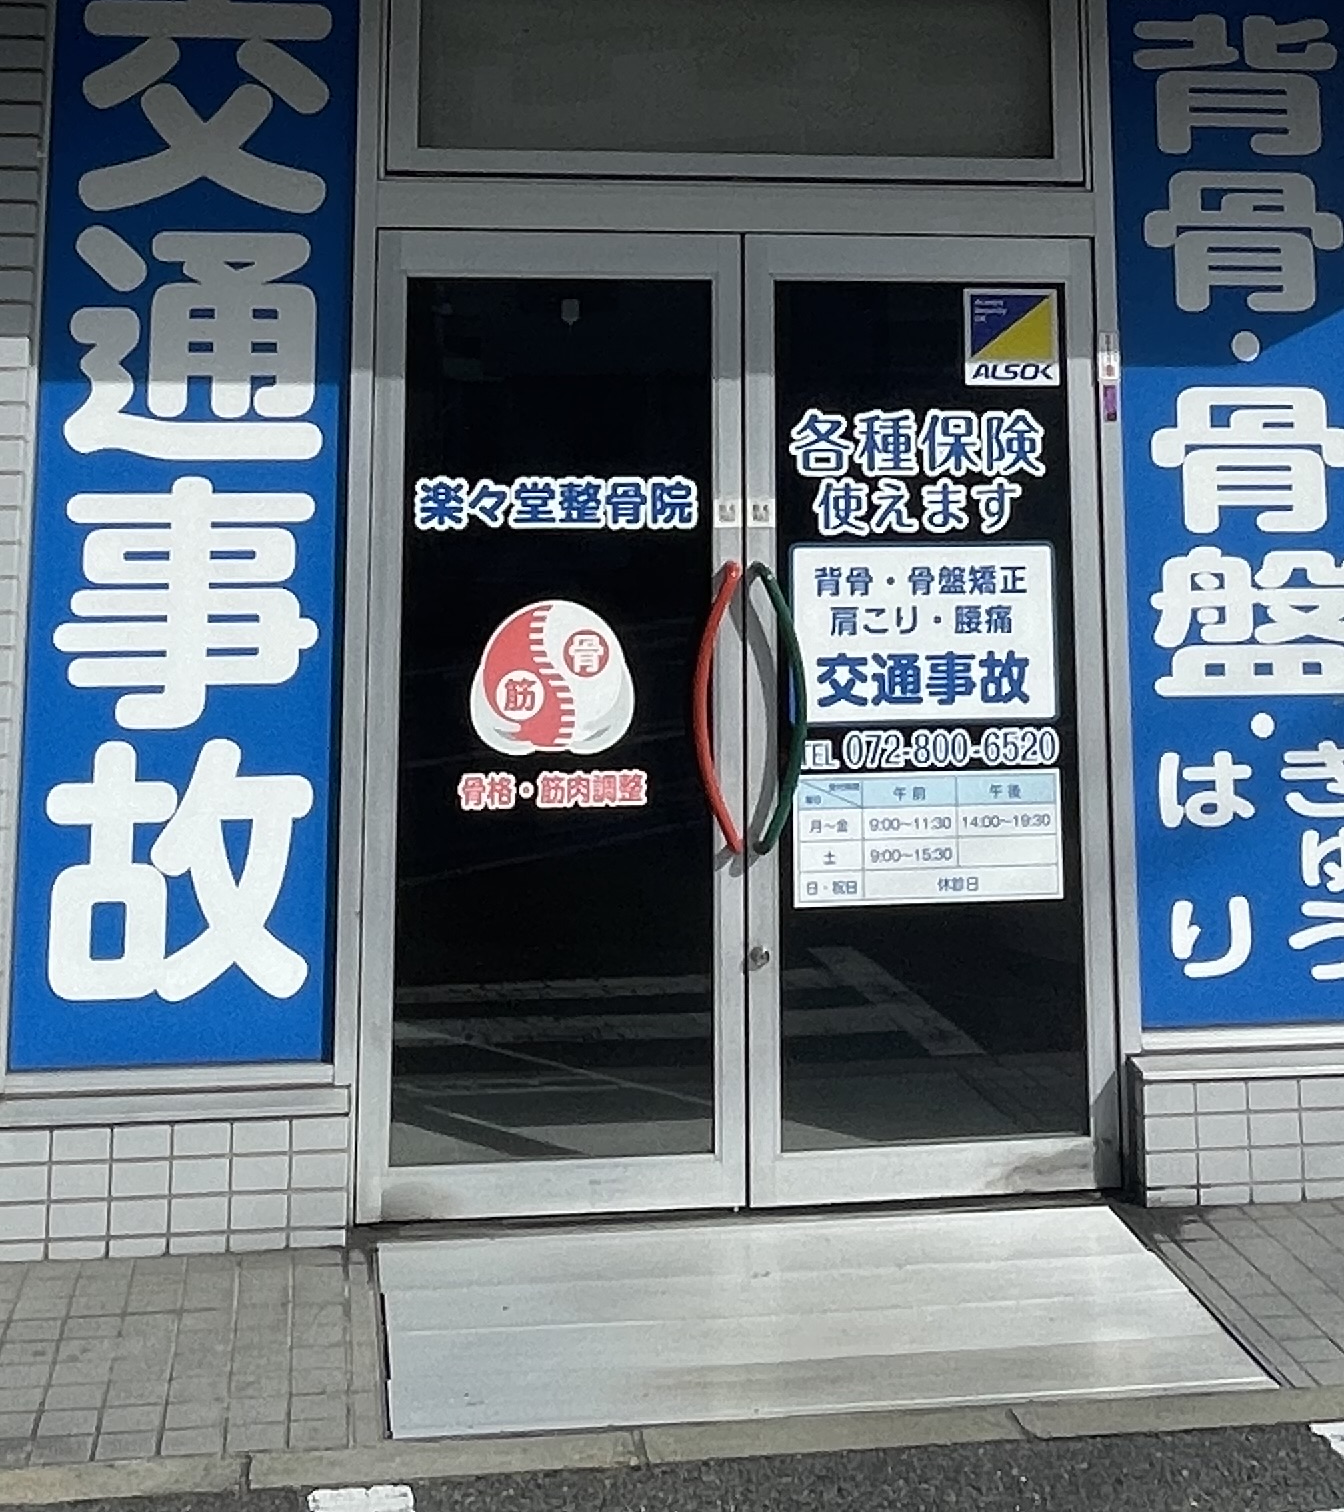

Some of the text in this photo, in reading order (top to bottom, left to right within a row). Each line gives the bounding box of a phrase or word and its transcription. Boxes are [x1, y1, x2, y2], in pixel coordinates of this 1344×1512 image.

[972, 364, 1053, 380] ALSOK
[791, 411, 1044, 475] 各種保険
[417, 478, 696, 528] 楽々堂整骨院
[815, 479, 1021, 534] 使えます
[814, 565, 1027, 597] 背骨・骨盤矯正
[830, 605, 1013, 637] 肩こり・腰痛
[569, 634, 603, 673] 骨
[504, 678, 536, 711] 筋
[816, 650, 1030, 707] 交通事故
[843, 727, 1059, 768] 072-800-6520
[459, 771, 646, 809] 骨格・筋肉調整
[1157, 750, 1254, 978] はり
